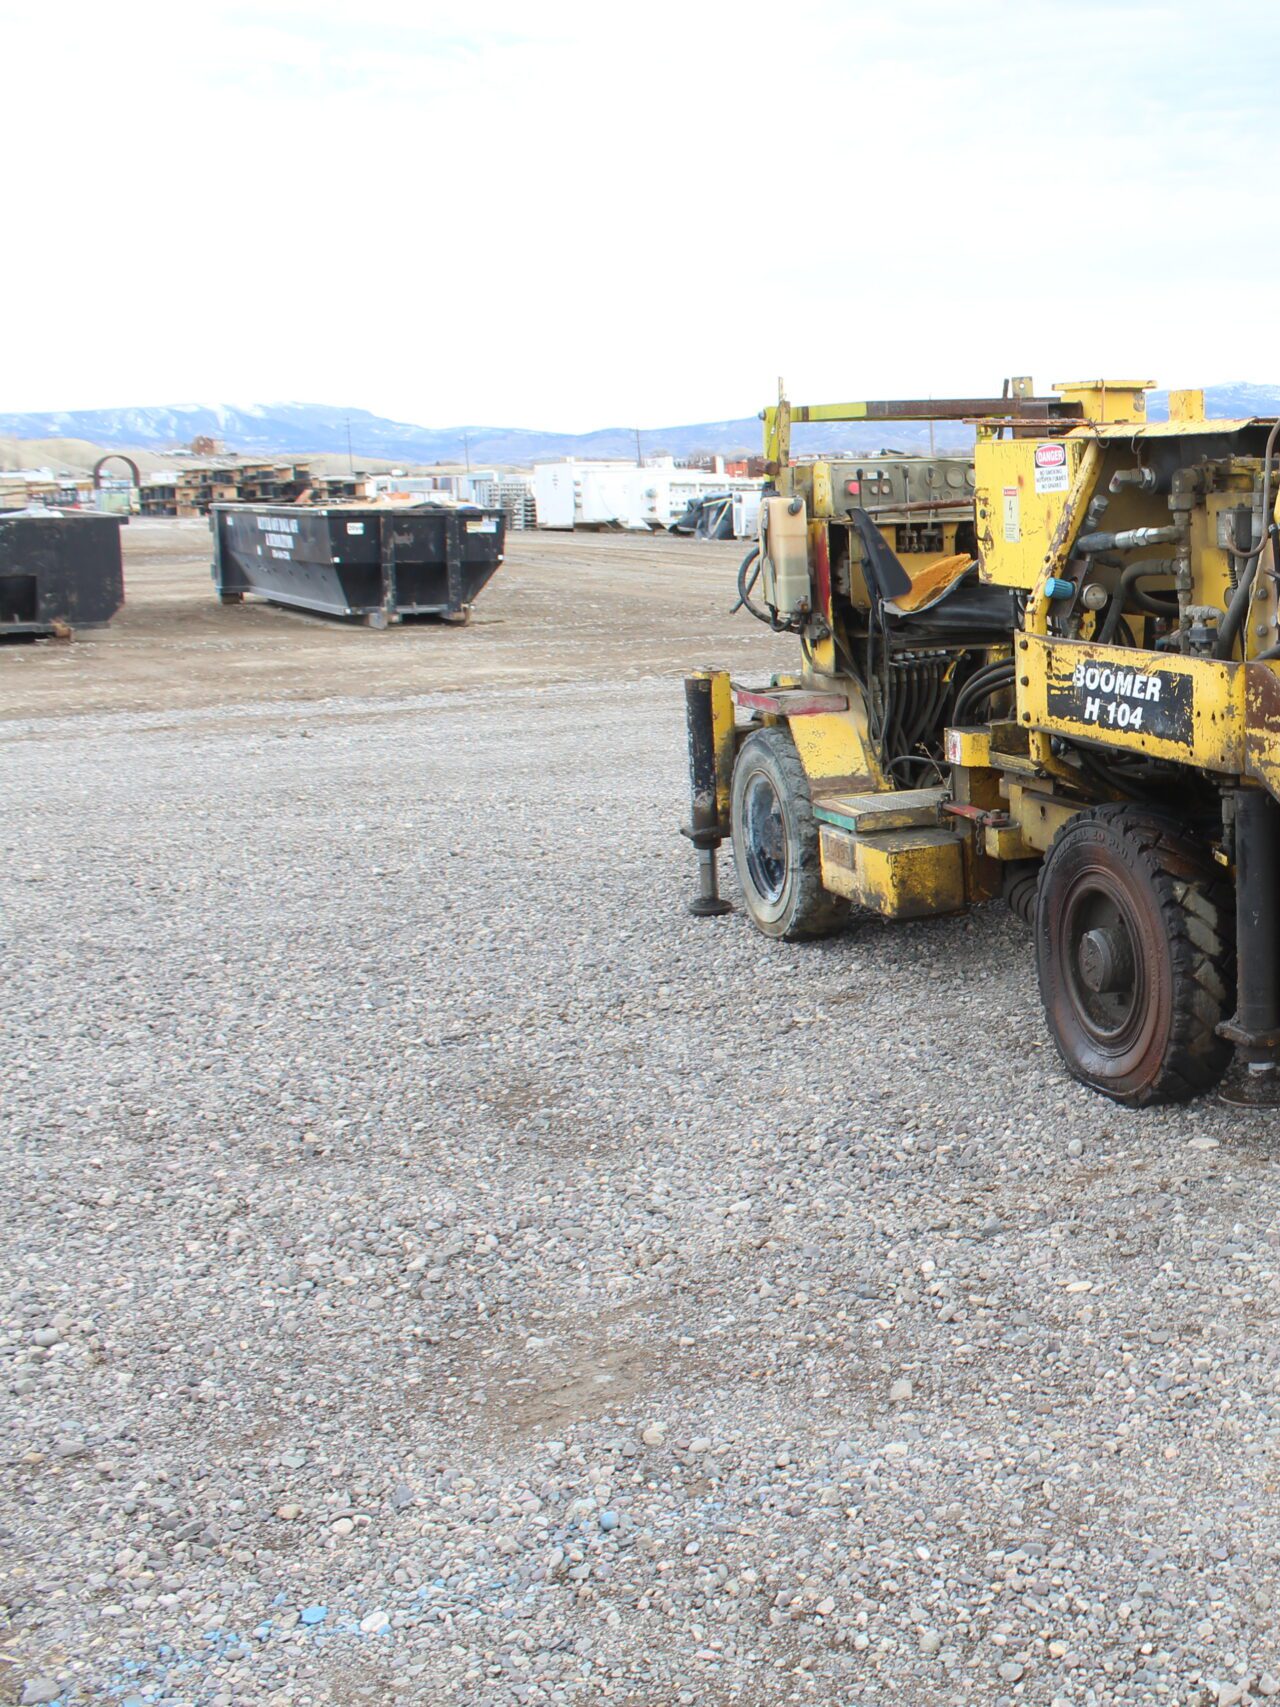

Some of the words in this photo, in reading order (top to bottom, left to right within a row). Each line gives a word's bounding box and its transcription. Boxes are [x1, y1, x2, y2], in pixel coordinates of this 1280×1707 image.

[1037, 450, 1063, 462] DANGER
[1072, 664, 1162, 702] BOOMER
[1084, 696, 1101, 721] H
[1107, 702, 1144, 729] 104
